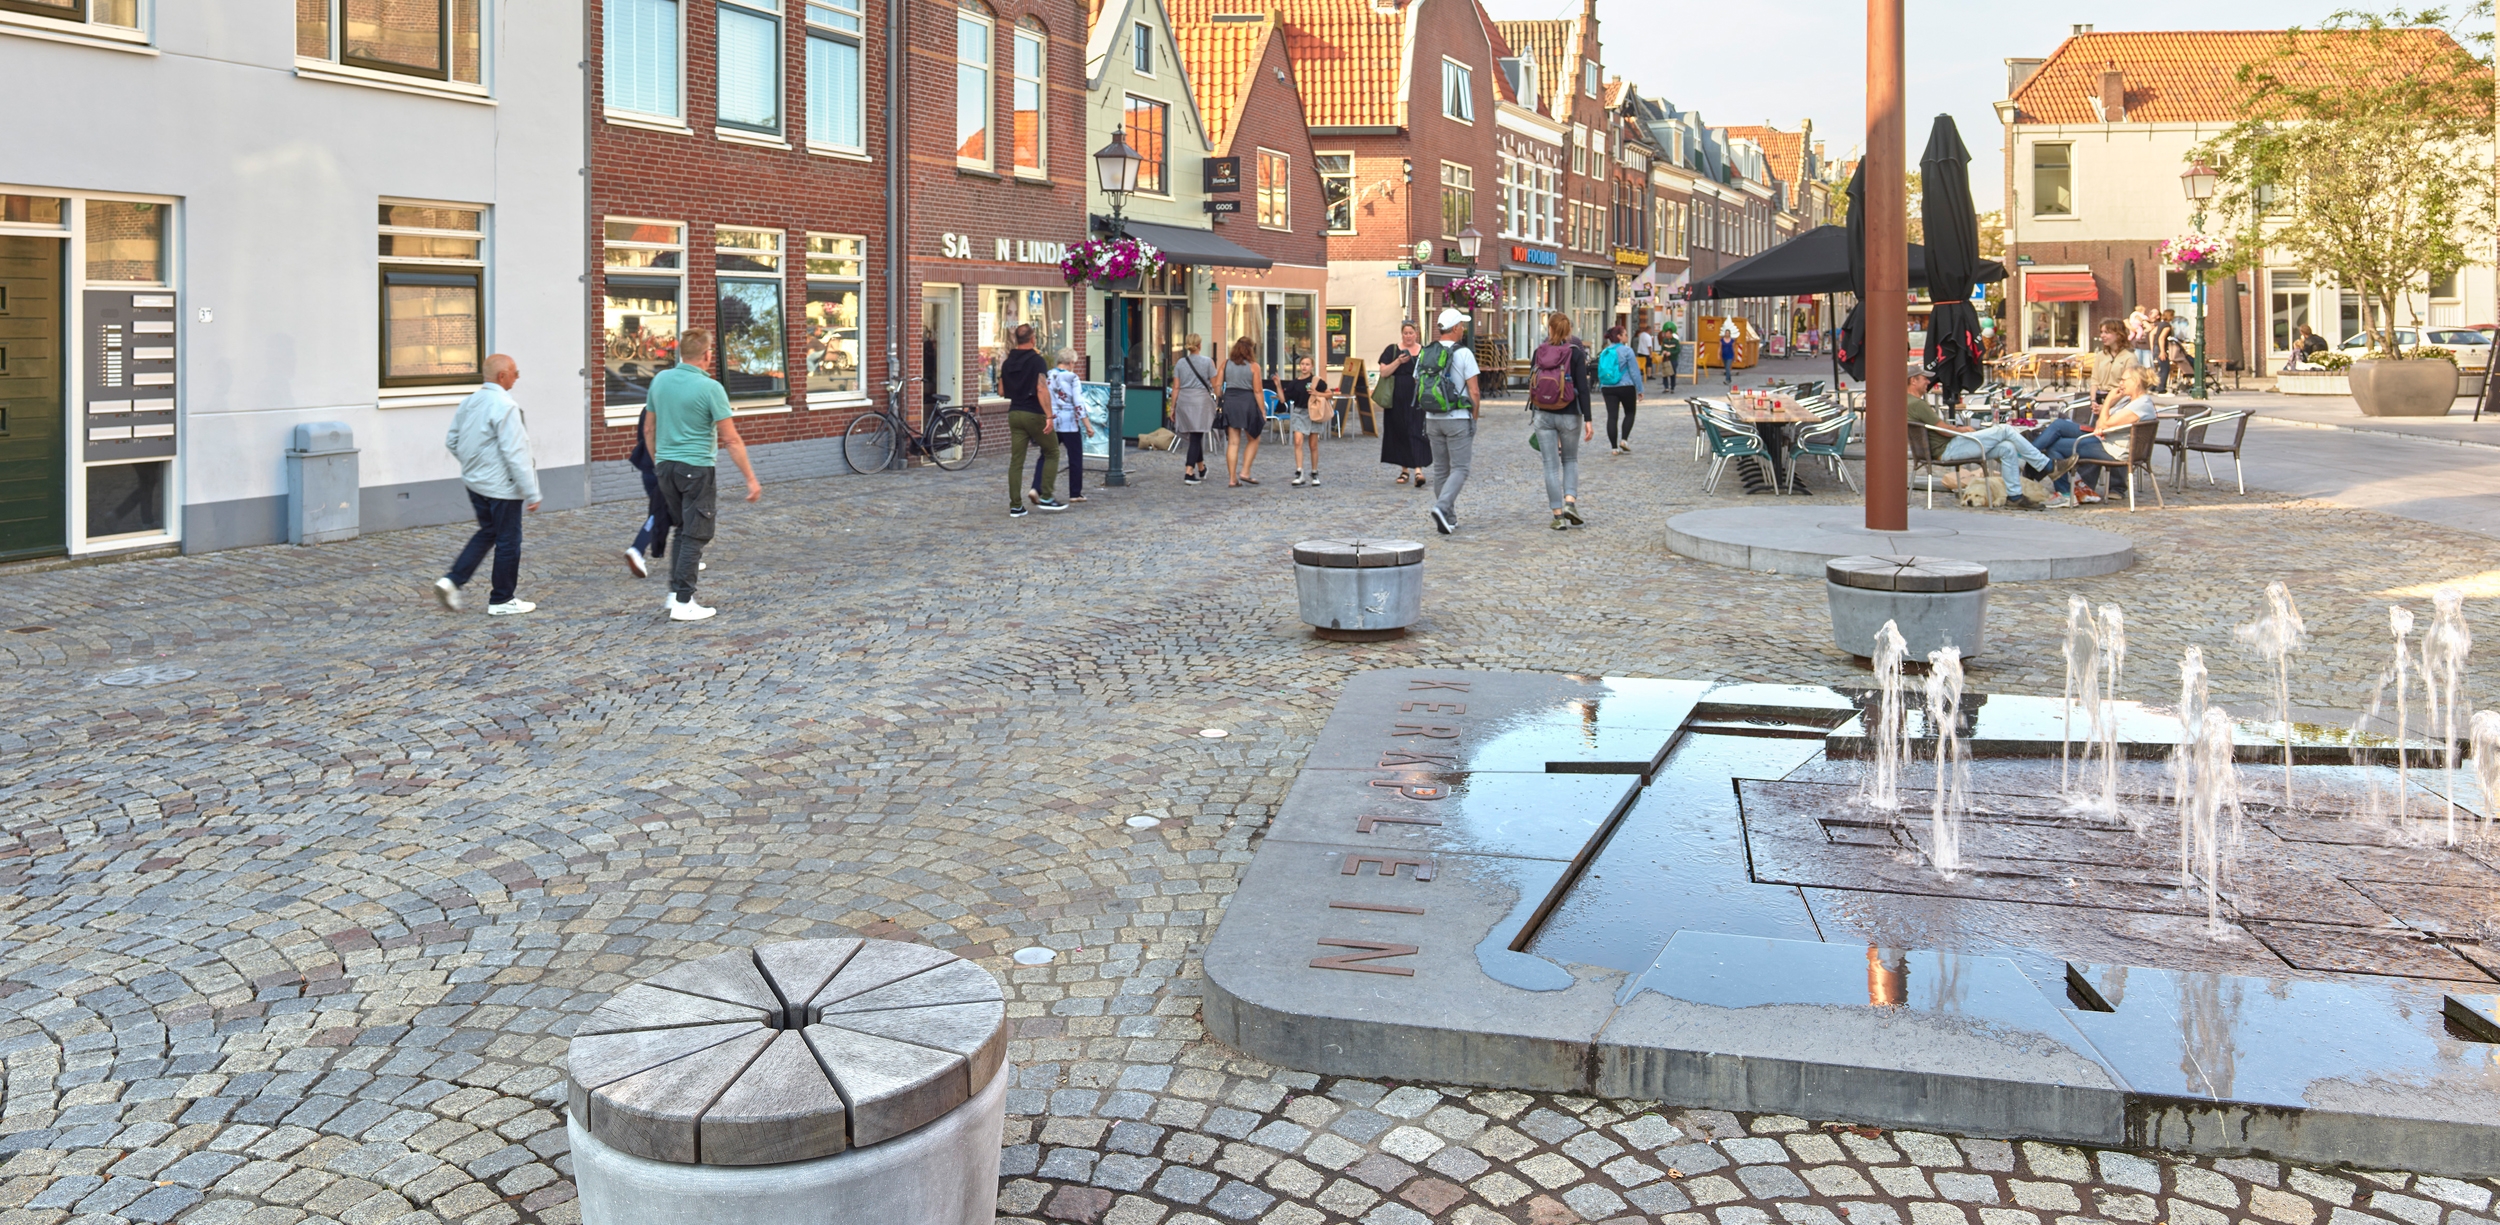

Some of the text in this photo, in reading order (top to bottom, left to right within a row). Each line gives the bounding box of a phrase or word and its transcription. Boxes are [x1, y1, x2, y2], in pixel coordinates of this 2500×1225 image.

[1215, 203, 1233, 211] GOOS
[1016, 240, 1067, 264] LINDA
[200, 309, 212, 321] 37
[1308, 679, 1472, 978] KERKPLEIN
